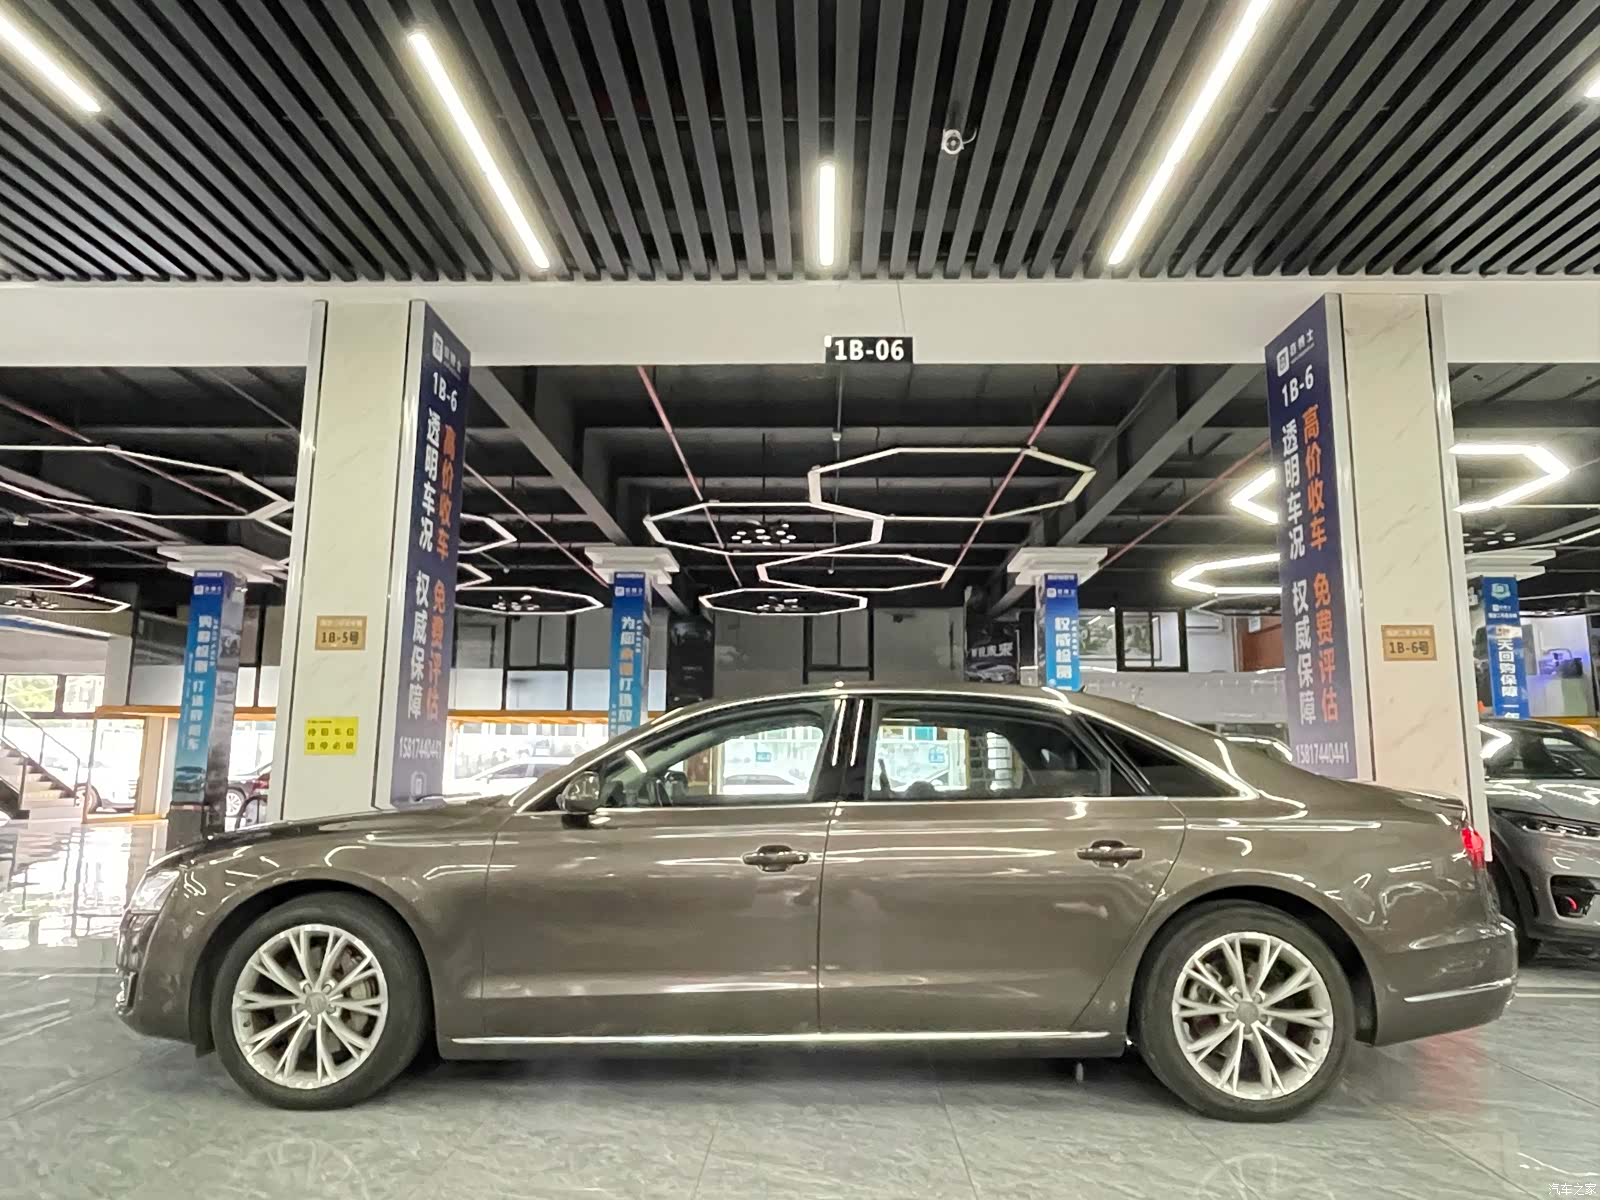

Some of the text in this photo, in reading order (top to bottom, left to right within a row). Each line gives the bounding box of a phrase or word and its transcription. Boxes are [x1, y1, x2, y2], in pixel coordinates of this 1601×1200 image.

[835, 339, 904, 361] 1B-06
[432, 371, 458, 412] 1B-6
[1281, 364, 1314, 407] 1B-6
[408, 407, 441, 720] 透明车况 权威保障
[1282, 419, 1316, 725] 透明车况 权威保障
[1302, 404, 1339, 722] 高价收车 免费评估
[1389, 640, 1429, 655] 1B-6号
[399, 735, 442, 760] 15817440441
[1296, 742, 1349, 765] 15817440441
